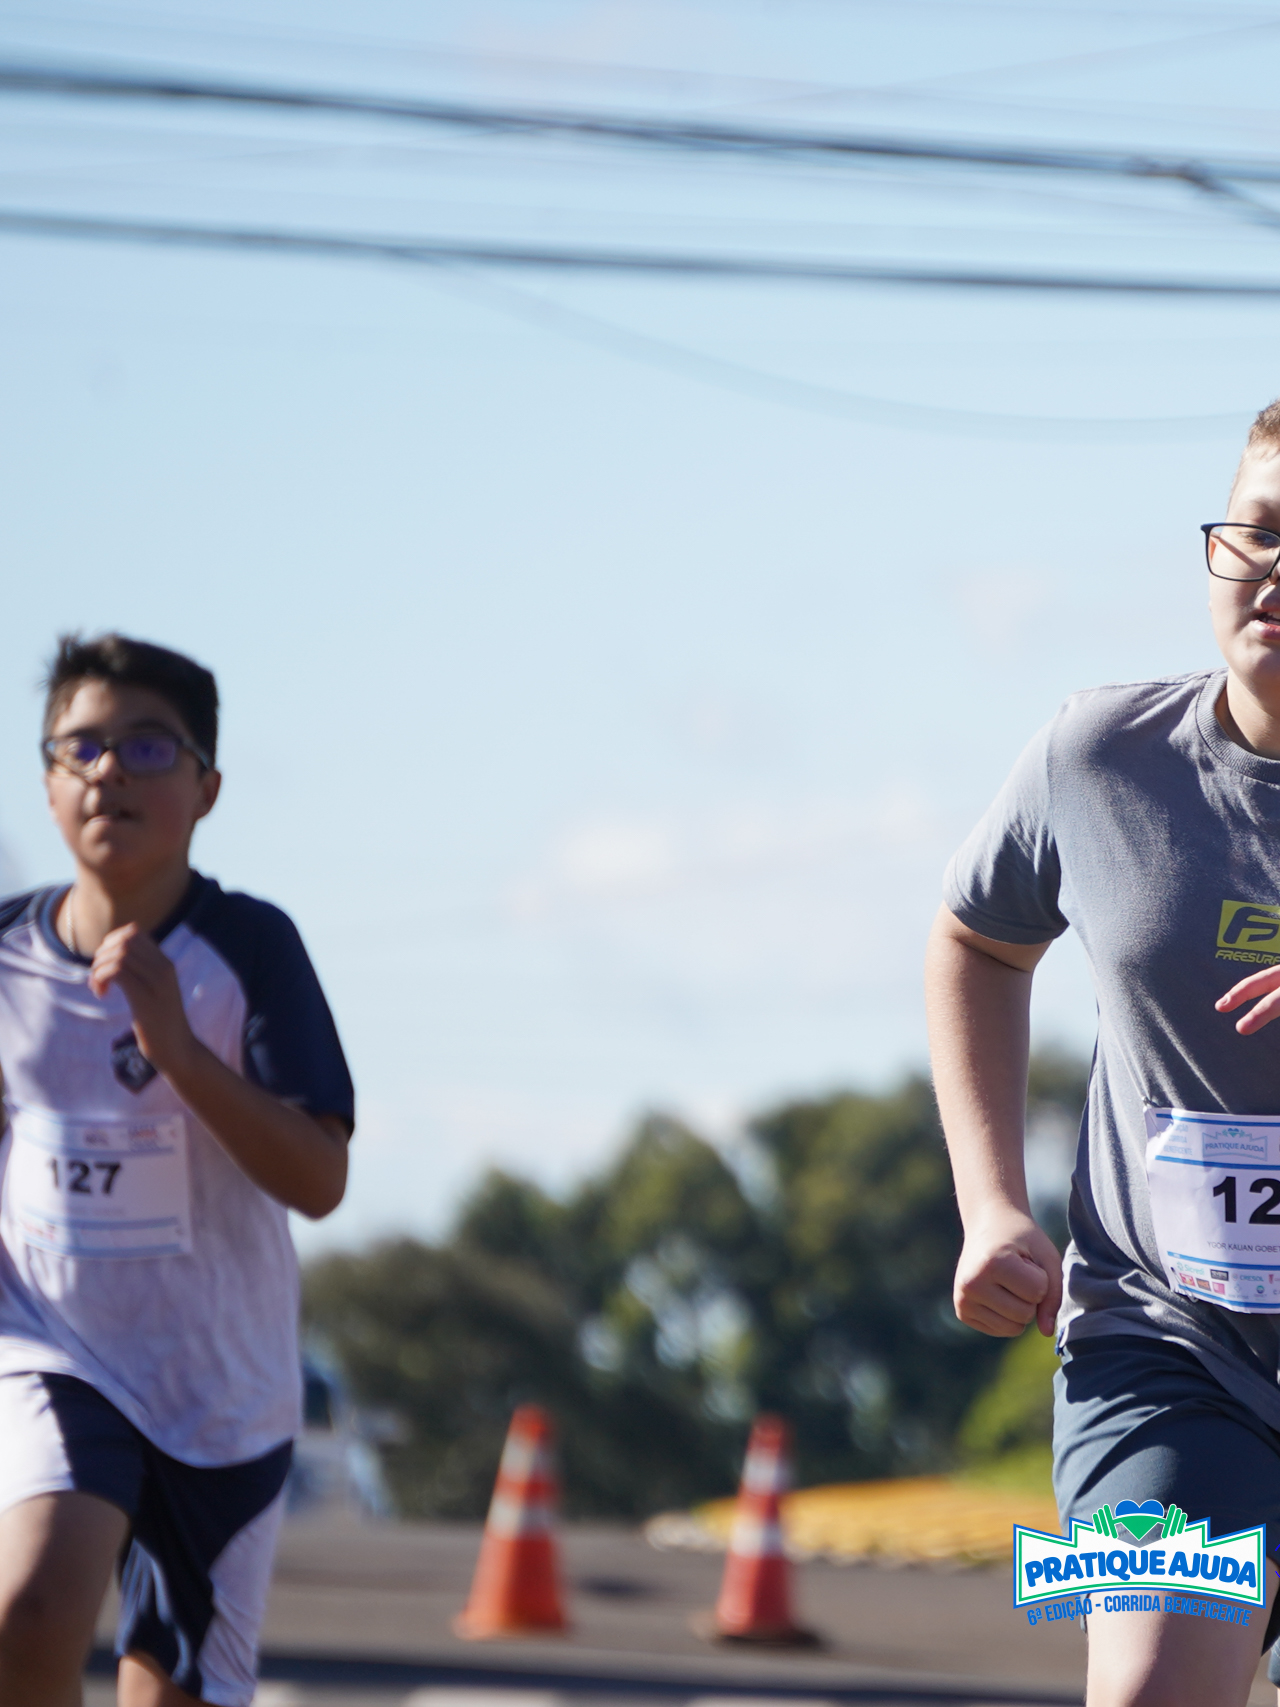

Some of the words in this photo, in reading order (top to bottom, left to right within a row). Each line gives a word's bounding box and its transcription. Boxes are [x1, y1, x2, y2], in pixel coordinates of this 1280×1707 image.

[1205, 1142, 1239, 1150] PRATIQUE
[1240, 1144, 1264, 1152] AJUDA
[48, 1158, 122, 1194] 127
